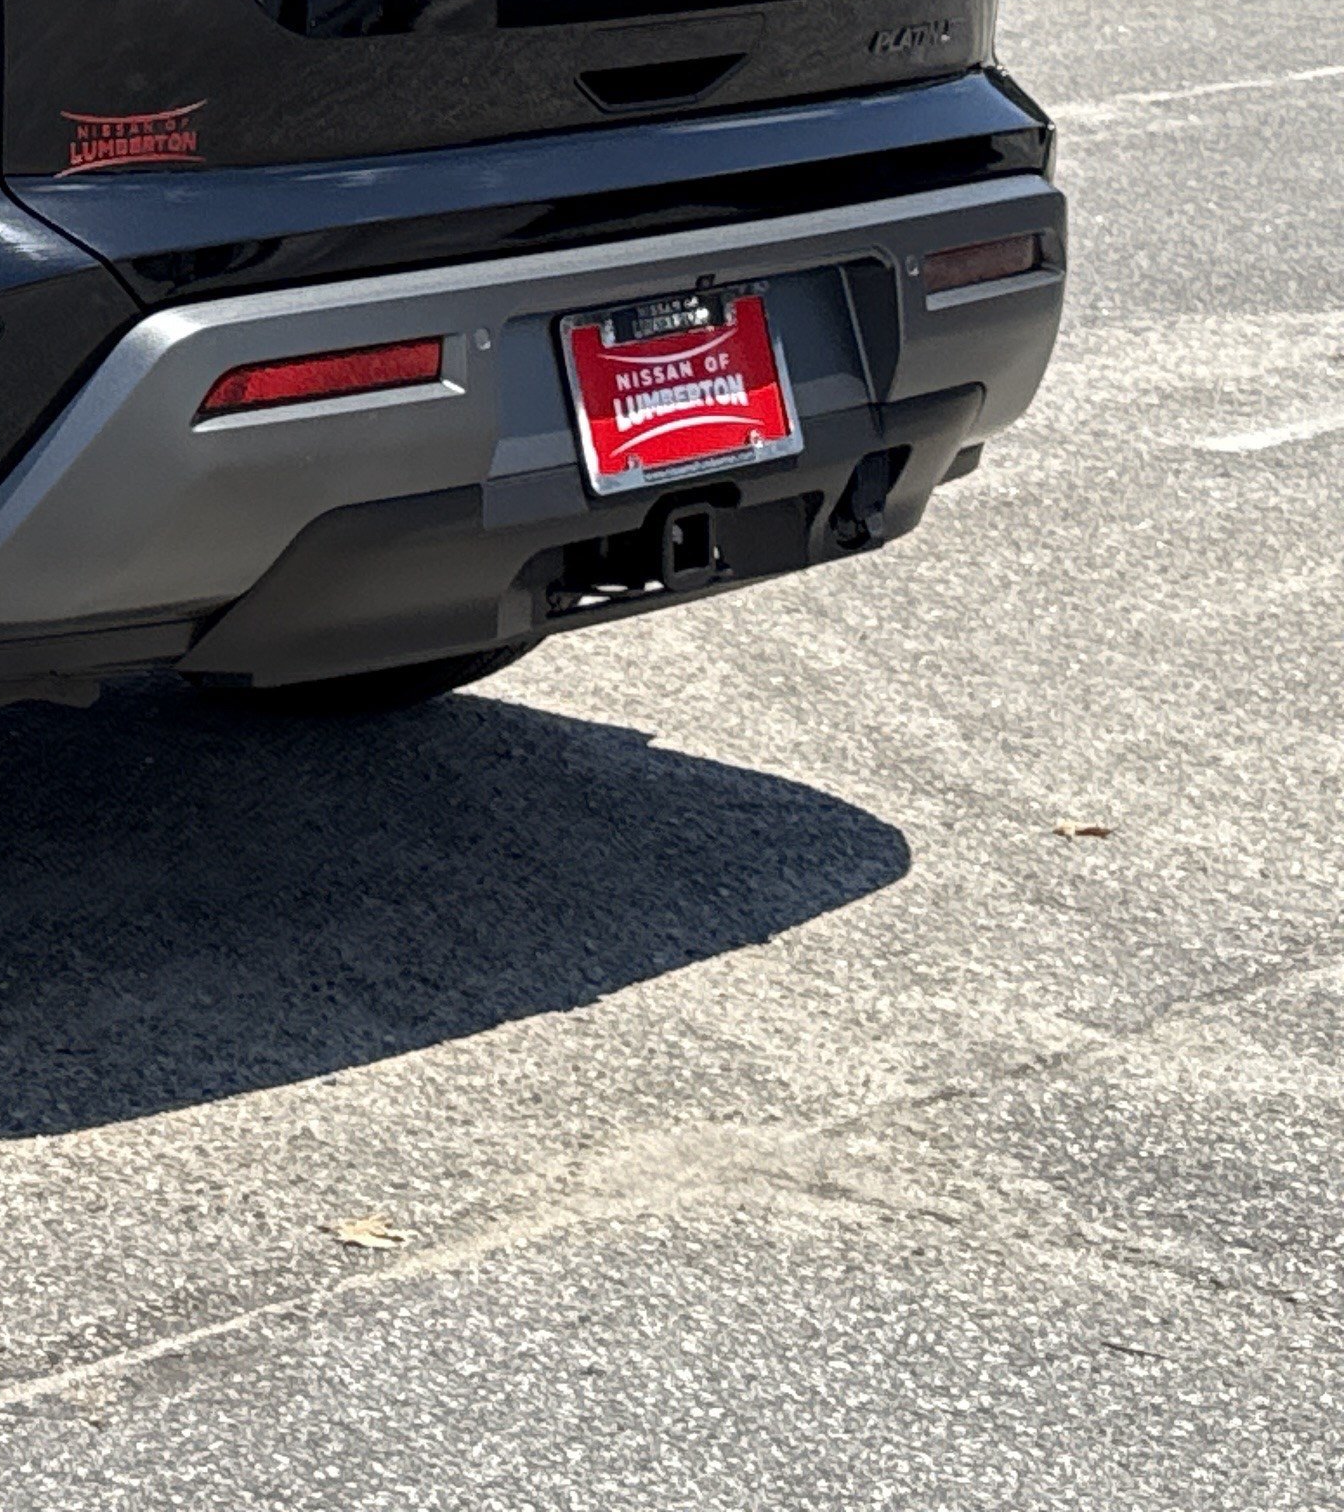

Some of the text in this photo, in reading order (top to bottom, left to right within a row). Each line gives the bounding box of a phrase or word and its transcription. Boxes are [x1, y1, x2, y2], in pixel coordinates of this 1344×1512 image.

[69, 132, 197, 166] LUMBERTON
[615, 353, 731, 391] NISSAN OF
[613, 374, 749, 432] LUMBERTON
